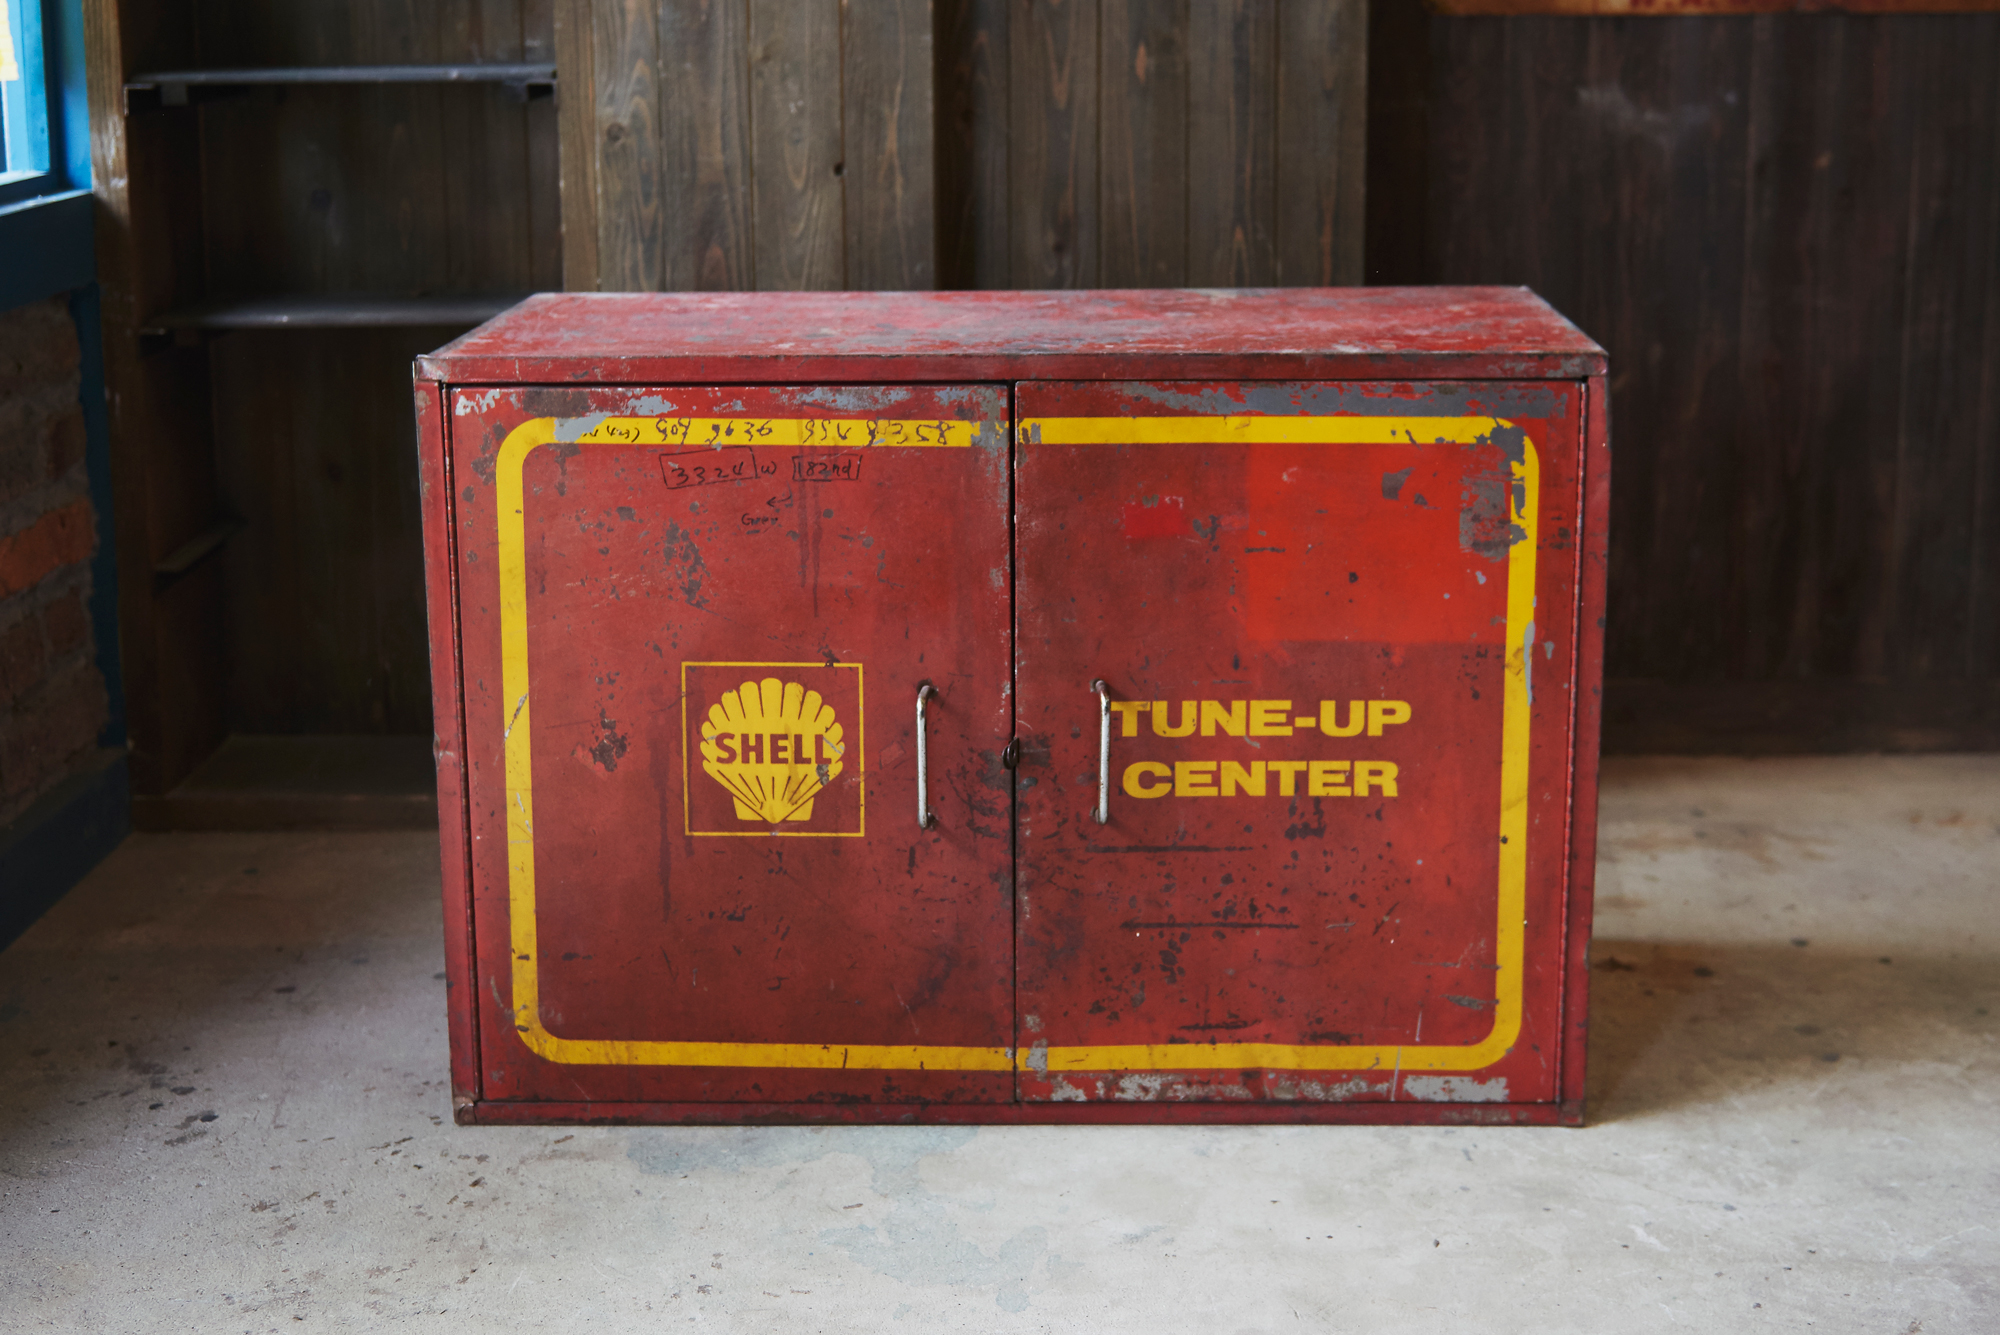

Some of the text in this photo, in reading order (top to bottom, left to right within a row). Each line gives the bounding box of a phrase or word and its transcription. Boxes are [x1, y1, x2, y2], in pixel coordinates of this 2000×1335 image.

[670, 460, 744, 486] 3324
[1109, 700, 1412, 738] TUNE-UP
[715, 732, 832, 765] SHELL
[1122, 760, 1400, 799] CENTER
